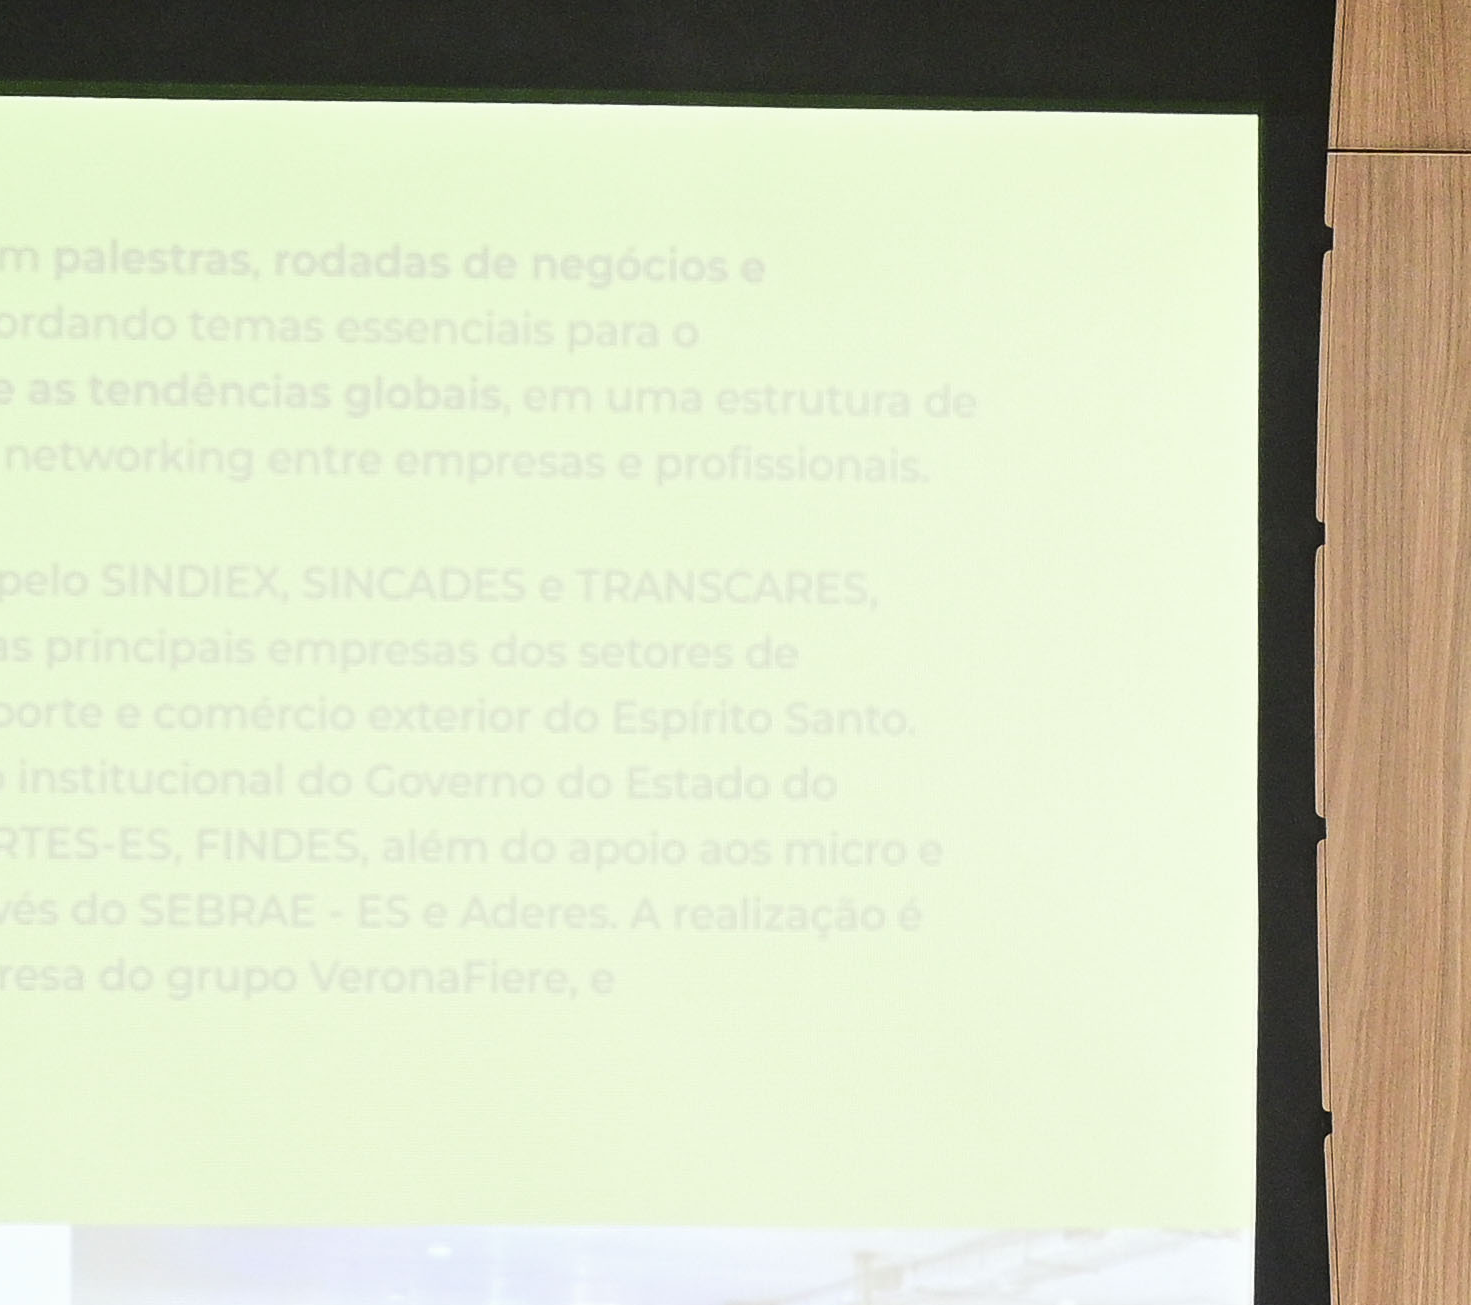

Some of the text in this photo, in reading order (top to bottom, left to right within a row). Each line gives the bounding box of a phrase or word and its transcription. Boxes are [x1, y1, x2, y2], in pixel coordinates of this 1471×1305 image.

[53, 237, 261, 281] palestras,
[274, 242, 453, 280] rodadas
[462, 244, 519, 281] de
[531, 245, 731, 291] negócios
[739, 255, 768, 286] e
[27, 377, 77, 407] as
[87, 372, 333, 411] tendências
[343, 374, 511, 420] globais,
[522, 385, 594, 414] em
[606, 386, 704, 415] uma
[715, 384, 912, 419] estrutura
[923, 382, 980, 421] de
[100, 561, 290, 604] SINDIEX,
[302, 564, 528, 603] SINCADES
[538, 574, 566, 603] e
[575, 566, 881, 613] TRANSCARES,
[195, 826, 370, 867] FINDES,
[381, 829, 489, 864] além
[500, 830, 558, 865] do
[567, 830, 689, 872] apoio
[698, 838, 773, 867] aos
[784, 831, 909, 867] micro
[917, 838, 945, 868] e
